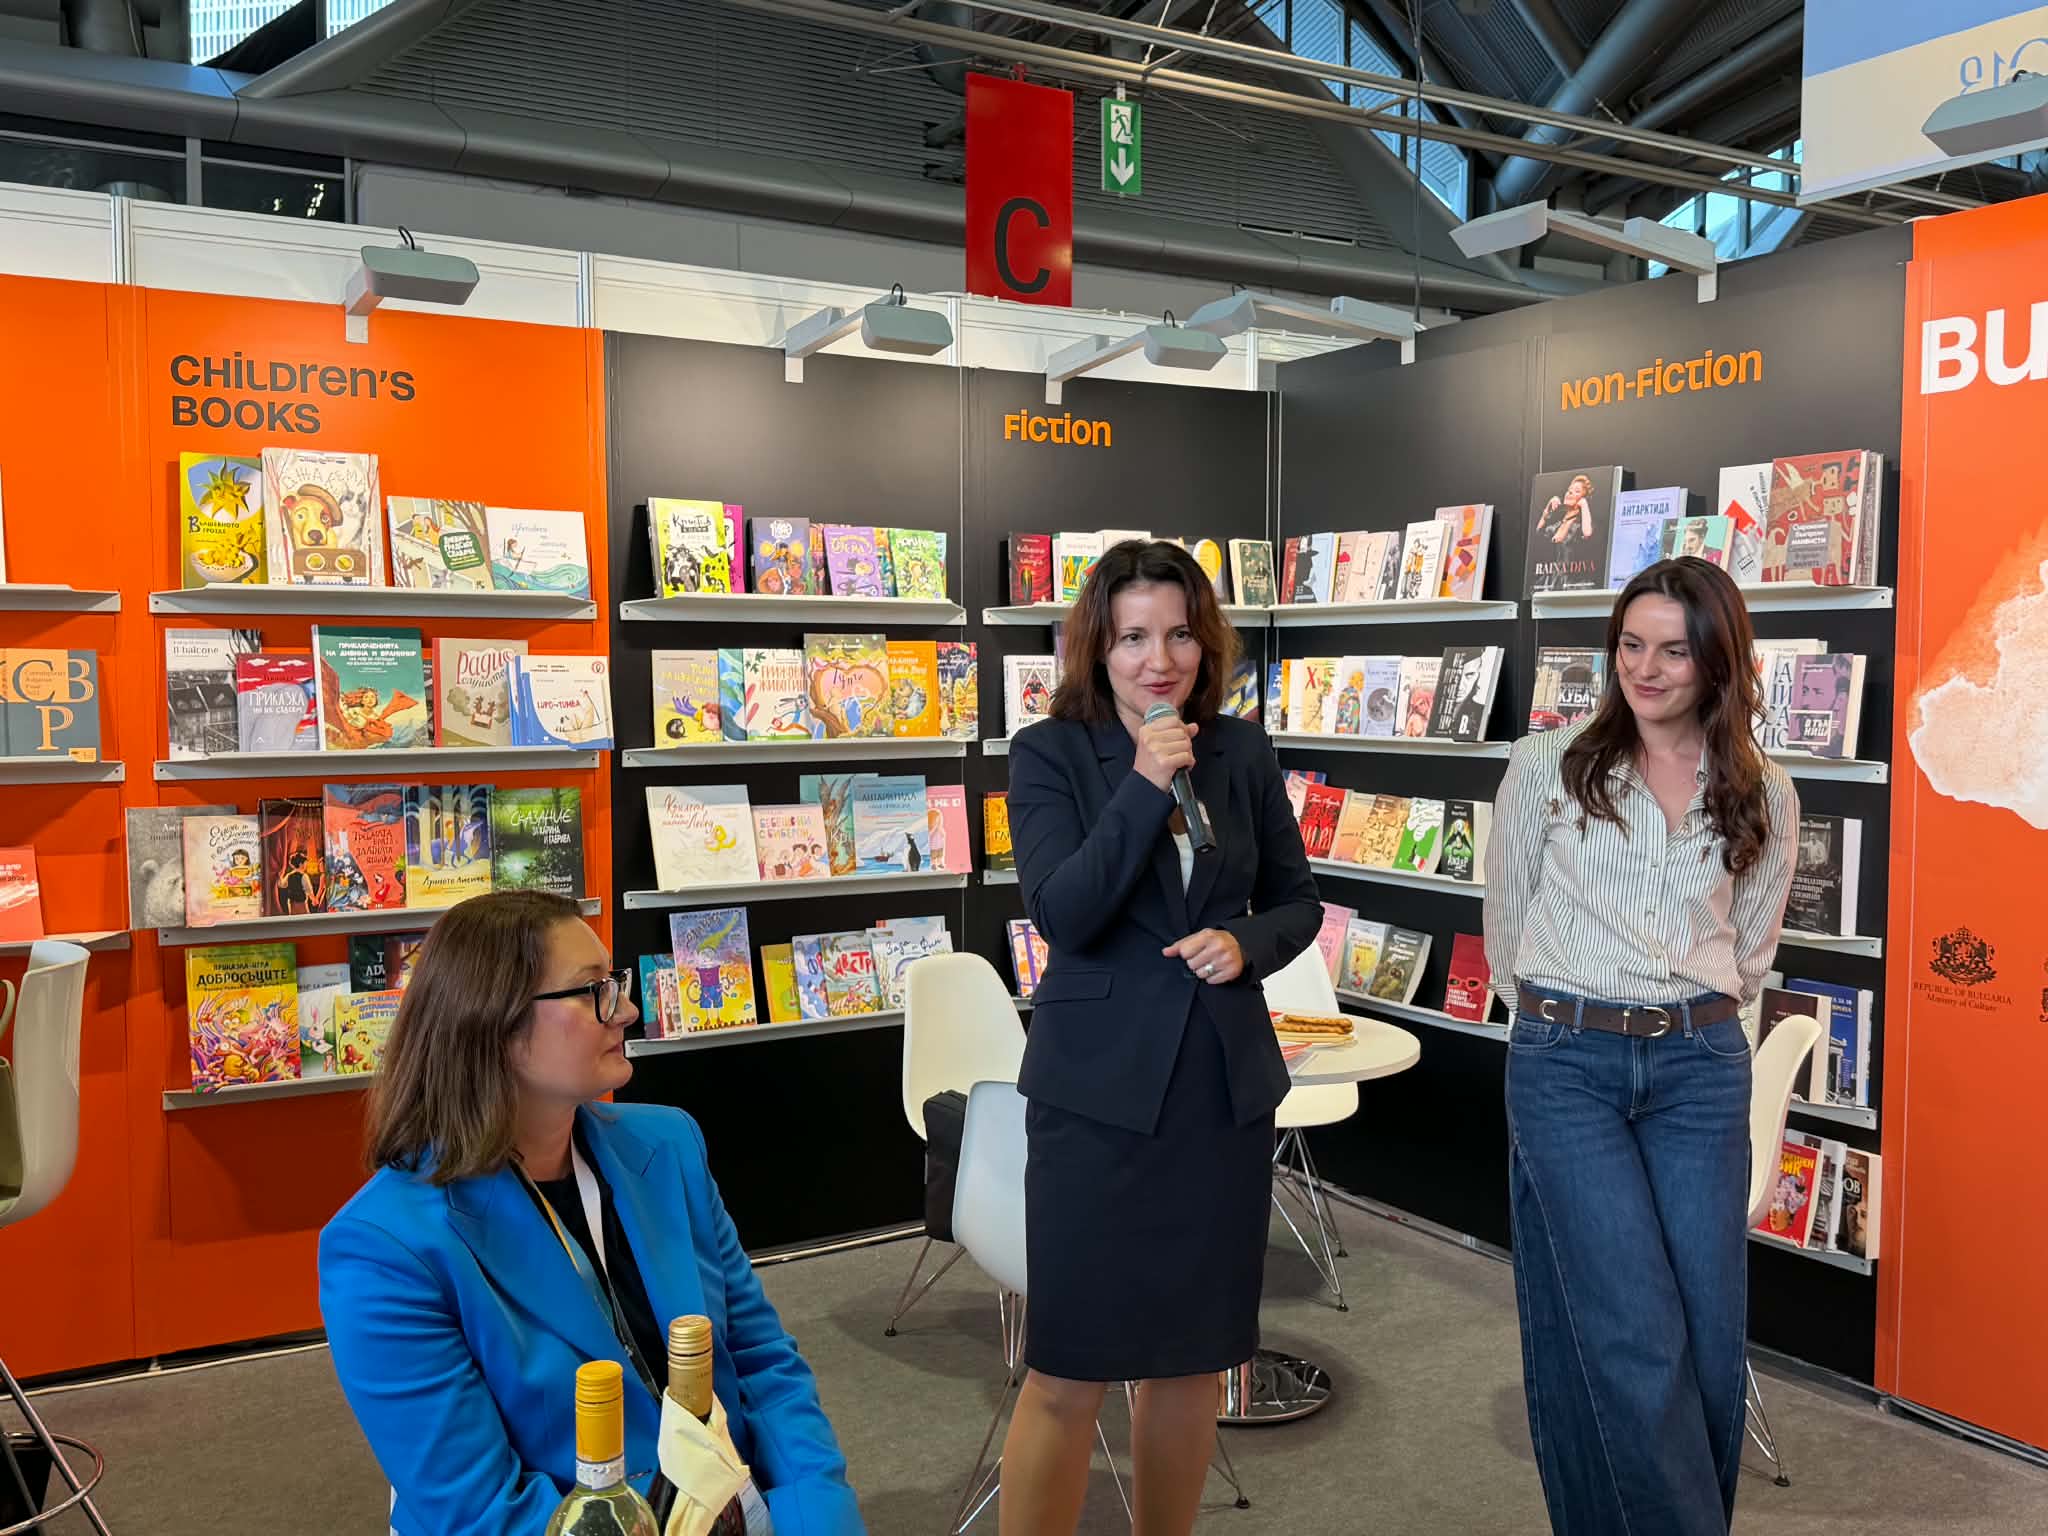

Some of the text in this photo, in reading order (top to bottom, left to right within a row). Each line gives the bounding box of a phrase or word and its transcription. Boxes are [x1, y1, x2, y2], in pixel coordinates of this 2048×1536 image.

[995, 197, 1050, 294] C
[171, 395, 321, 434] BOOKS
[1621, 502, 1669, 517] АНТАРКТИДА
[1559, 687, 1590, 704] КУБА
